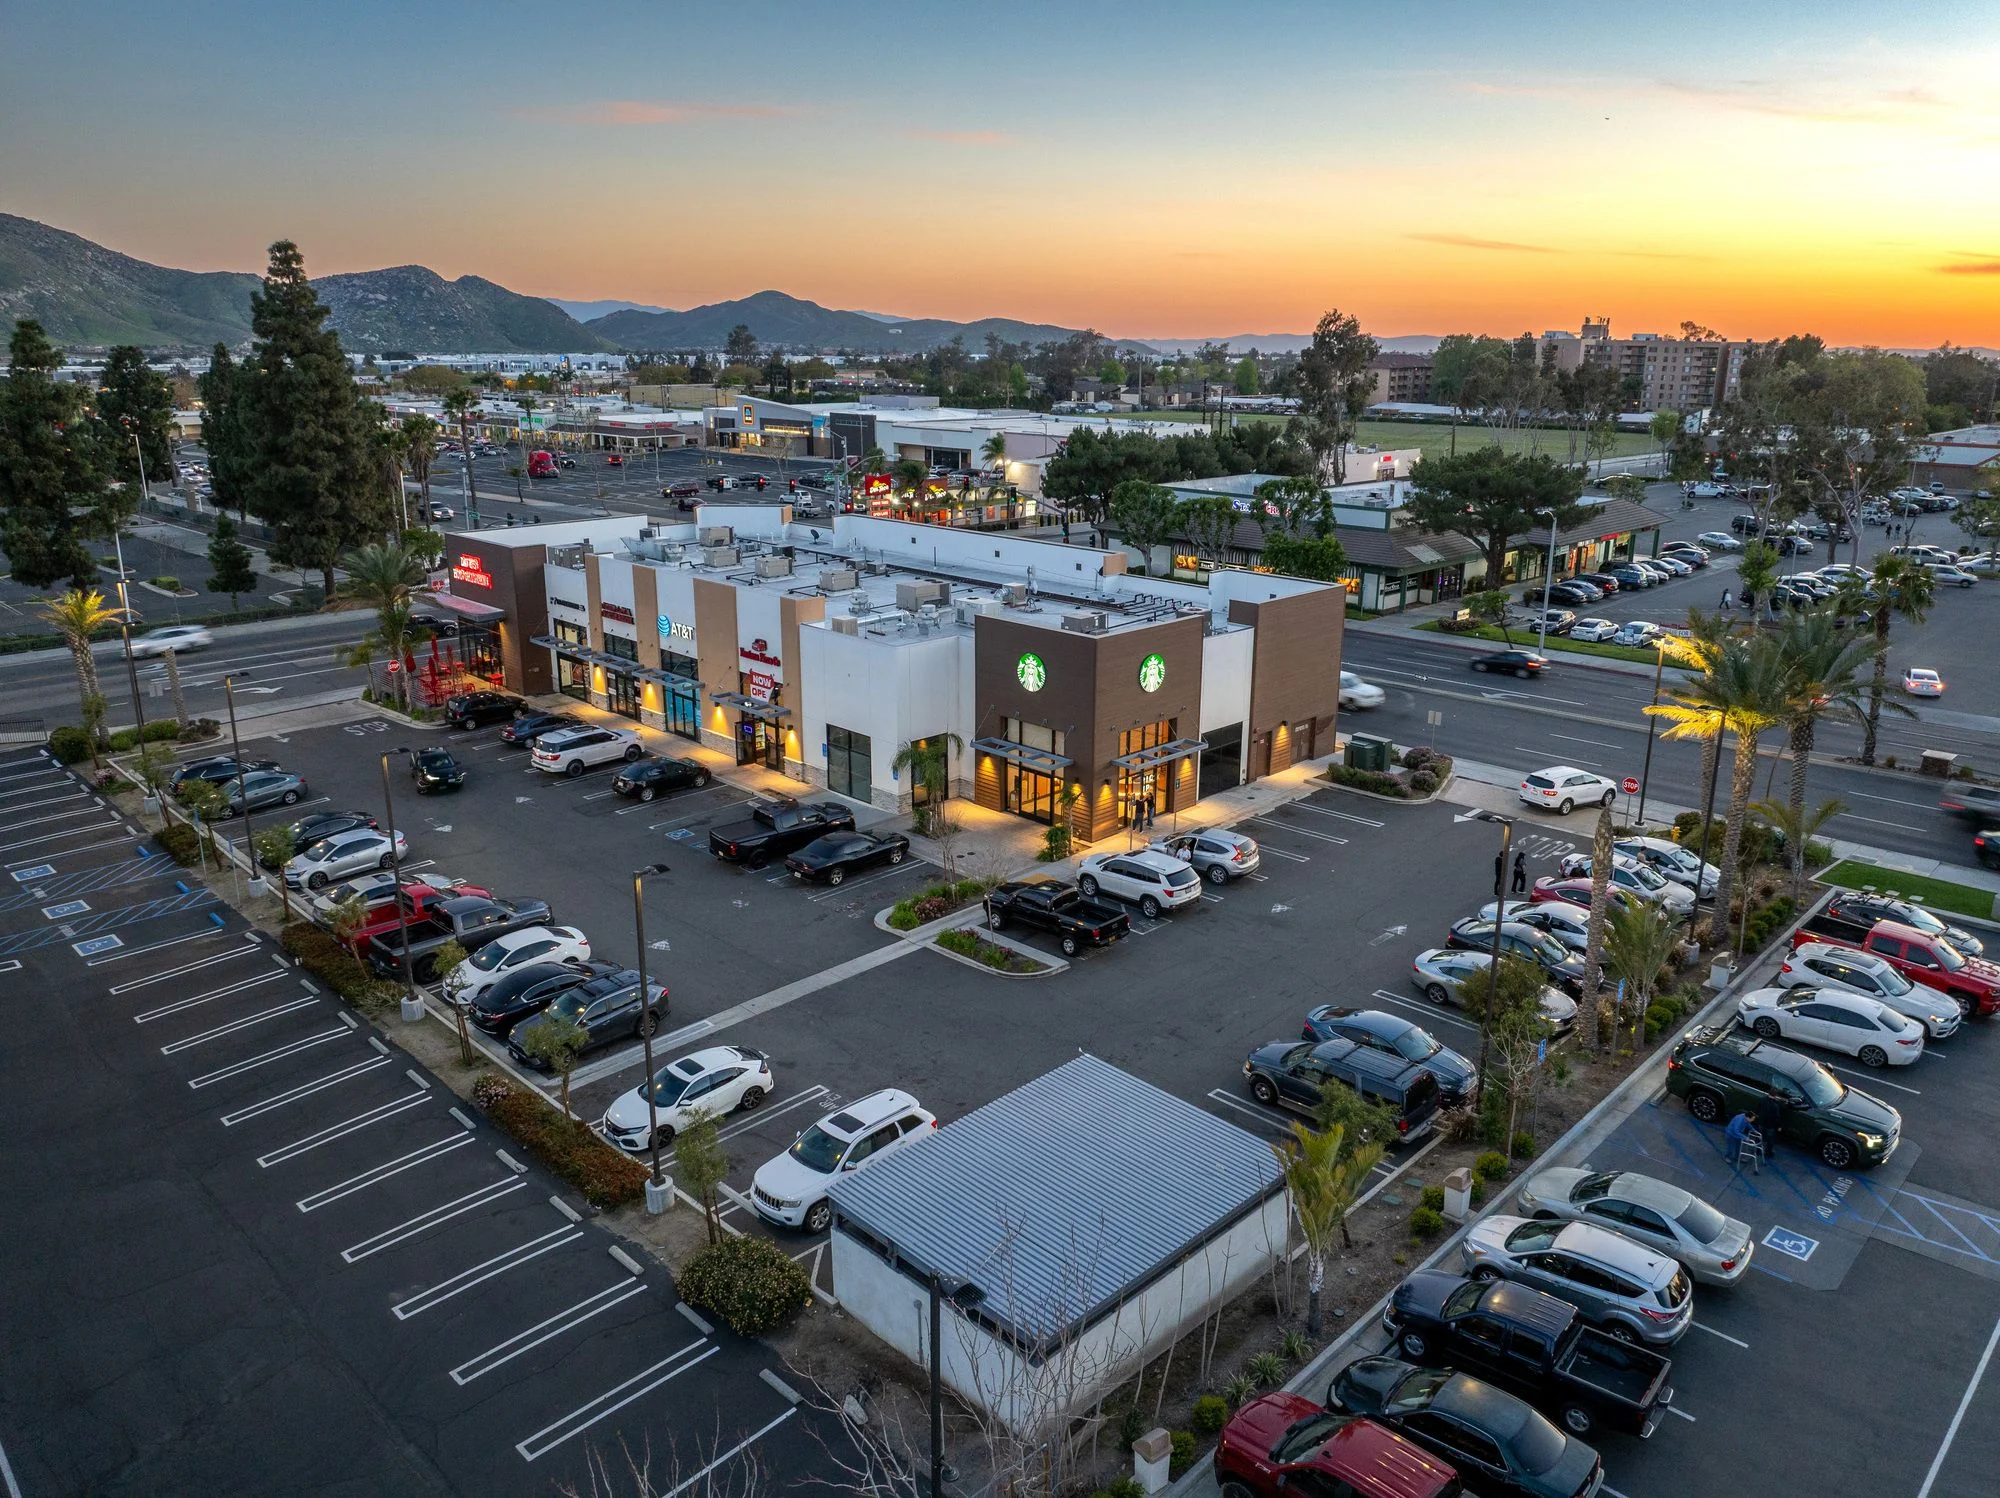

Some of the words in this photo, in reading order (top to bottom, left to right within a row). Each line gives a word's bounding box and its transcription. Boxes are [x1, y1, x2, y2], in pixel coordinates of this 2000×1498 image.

[671, 622, 694, 640] AT&T
[752, 674, 772, 689] NOW
[751, 687, 767, 699] OPE
[343, 721, 391, 736] STOP
[1623, 781, 1640, 790] STOP
[1509, 834, 1576, 861] STOP
